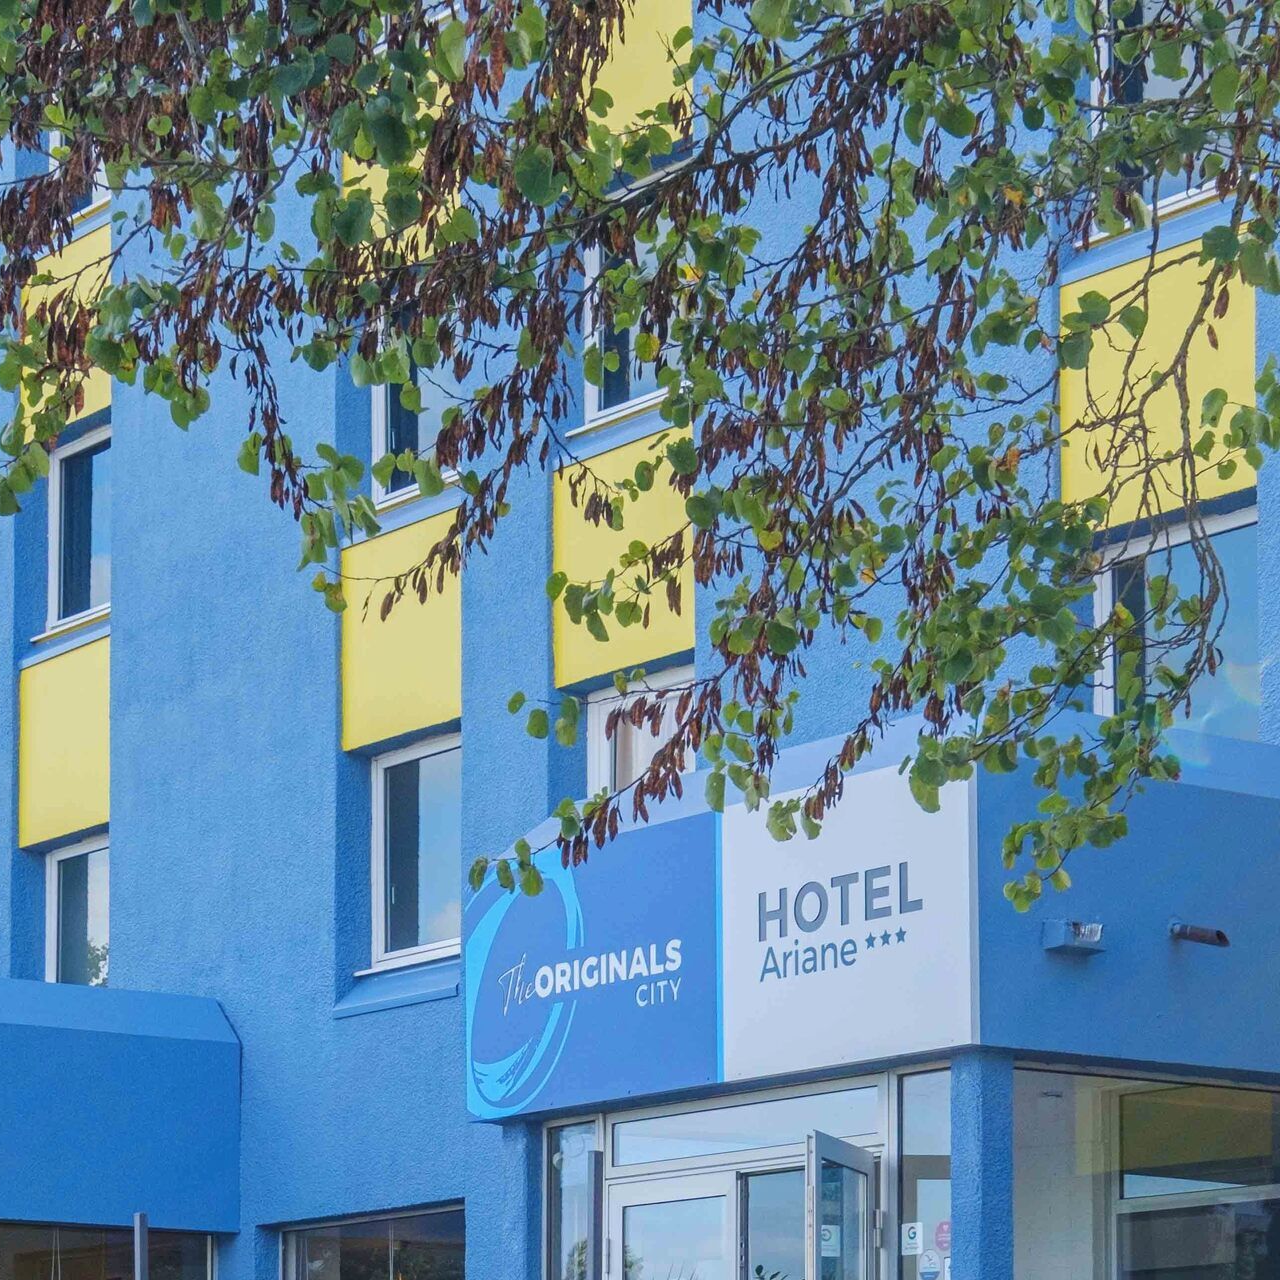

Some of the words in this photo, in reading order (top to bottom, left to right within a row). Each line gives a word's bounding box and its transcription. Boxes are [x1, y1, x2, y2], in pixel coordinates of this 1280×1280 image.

[758, 861, 923, 943] HOTEL
[497, 952, 536, 1017] The
[534, 938, 682, 999] ORIGINALS
[759, 938, 858, 983] Ariane
[635, 977, 682, 1007] CITY
